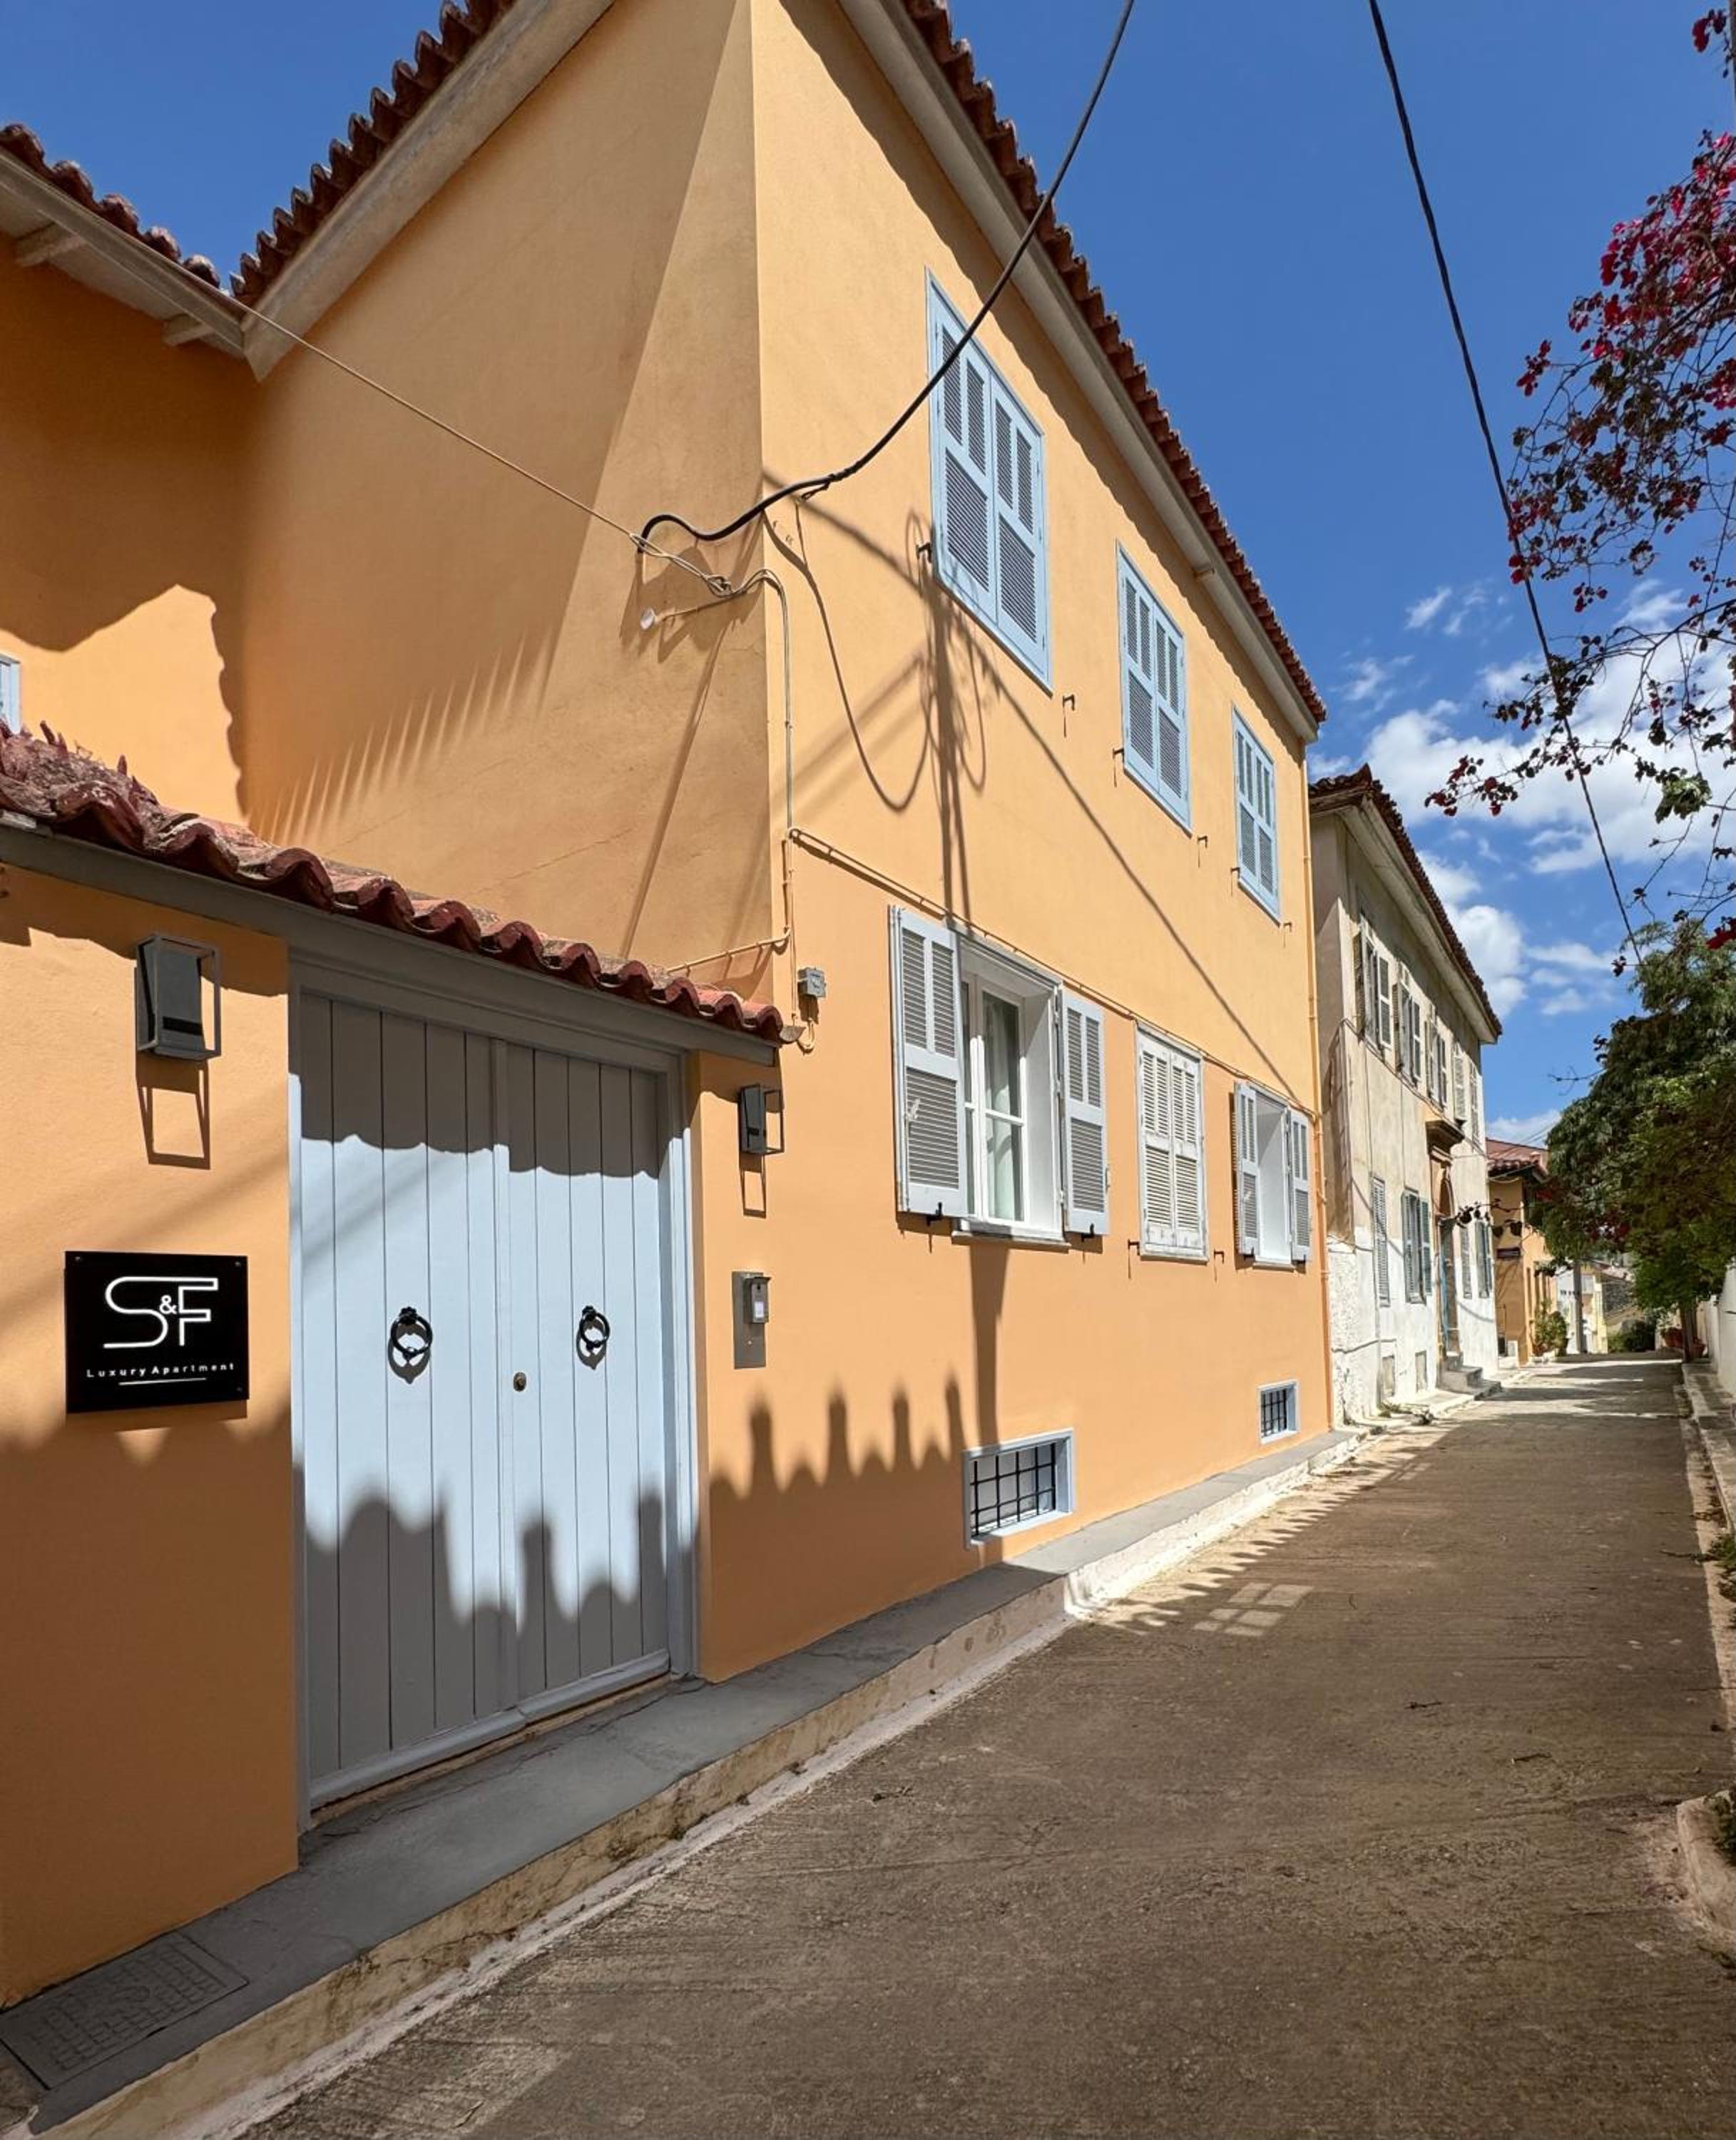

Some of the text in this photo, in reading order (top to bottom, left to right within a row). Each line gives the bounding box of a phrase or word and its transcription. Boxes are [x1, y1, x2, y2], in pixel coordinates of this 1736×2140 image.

[103, 1275, 219, 1349] S&F
[86, 1362, 234, 1377] Luxury Apartment
